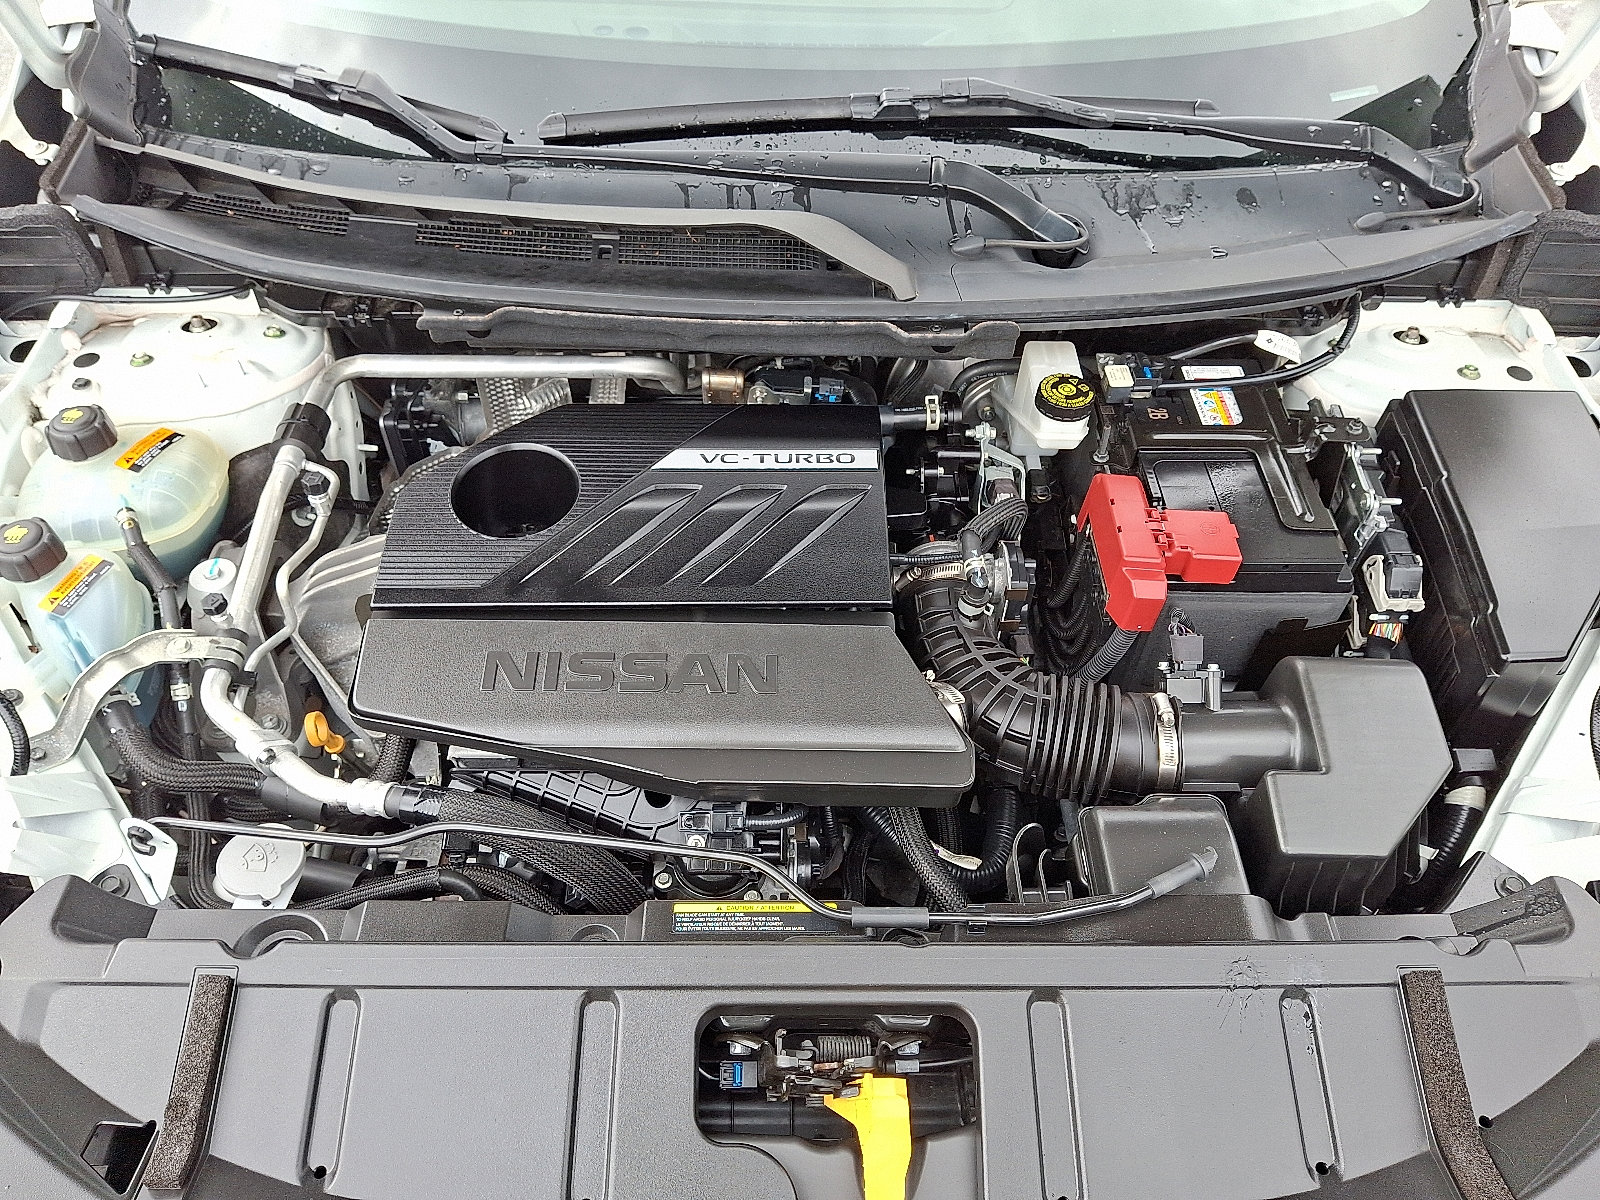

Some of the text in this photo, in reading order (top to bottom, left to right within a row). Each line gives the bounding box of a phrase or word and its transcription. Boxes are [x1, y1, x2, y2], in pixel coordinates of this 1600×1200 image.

[1147, 407, 1170, 420] 2B
[700, 452, 856, 464] VC-TURBO
[480, 651, 778, 694] NISSAN
